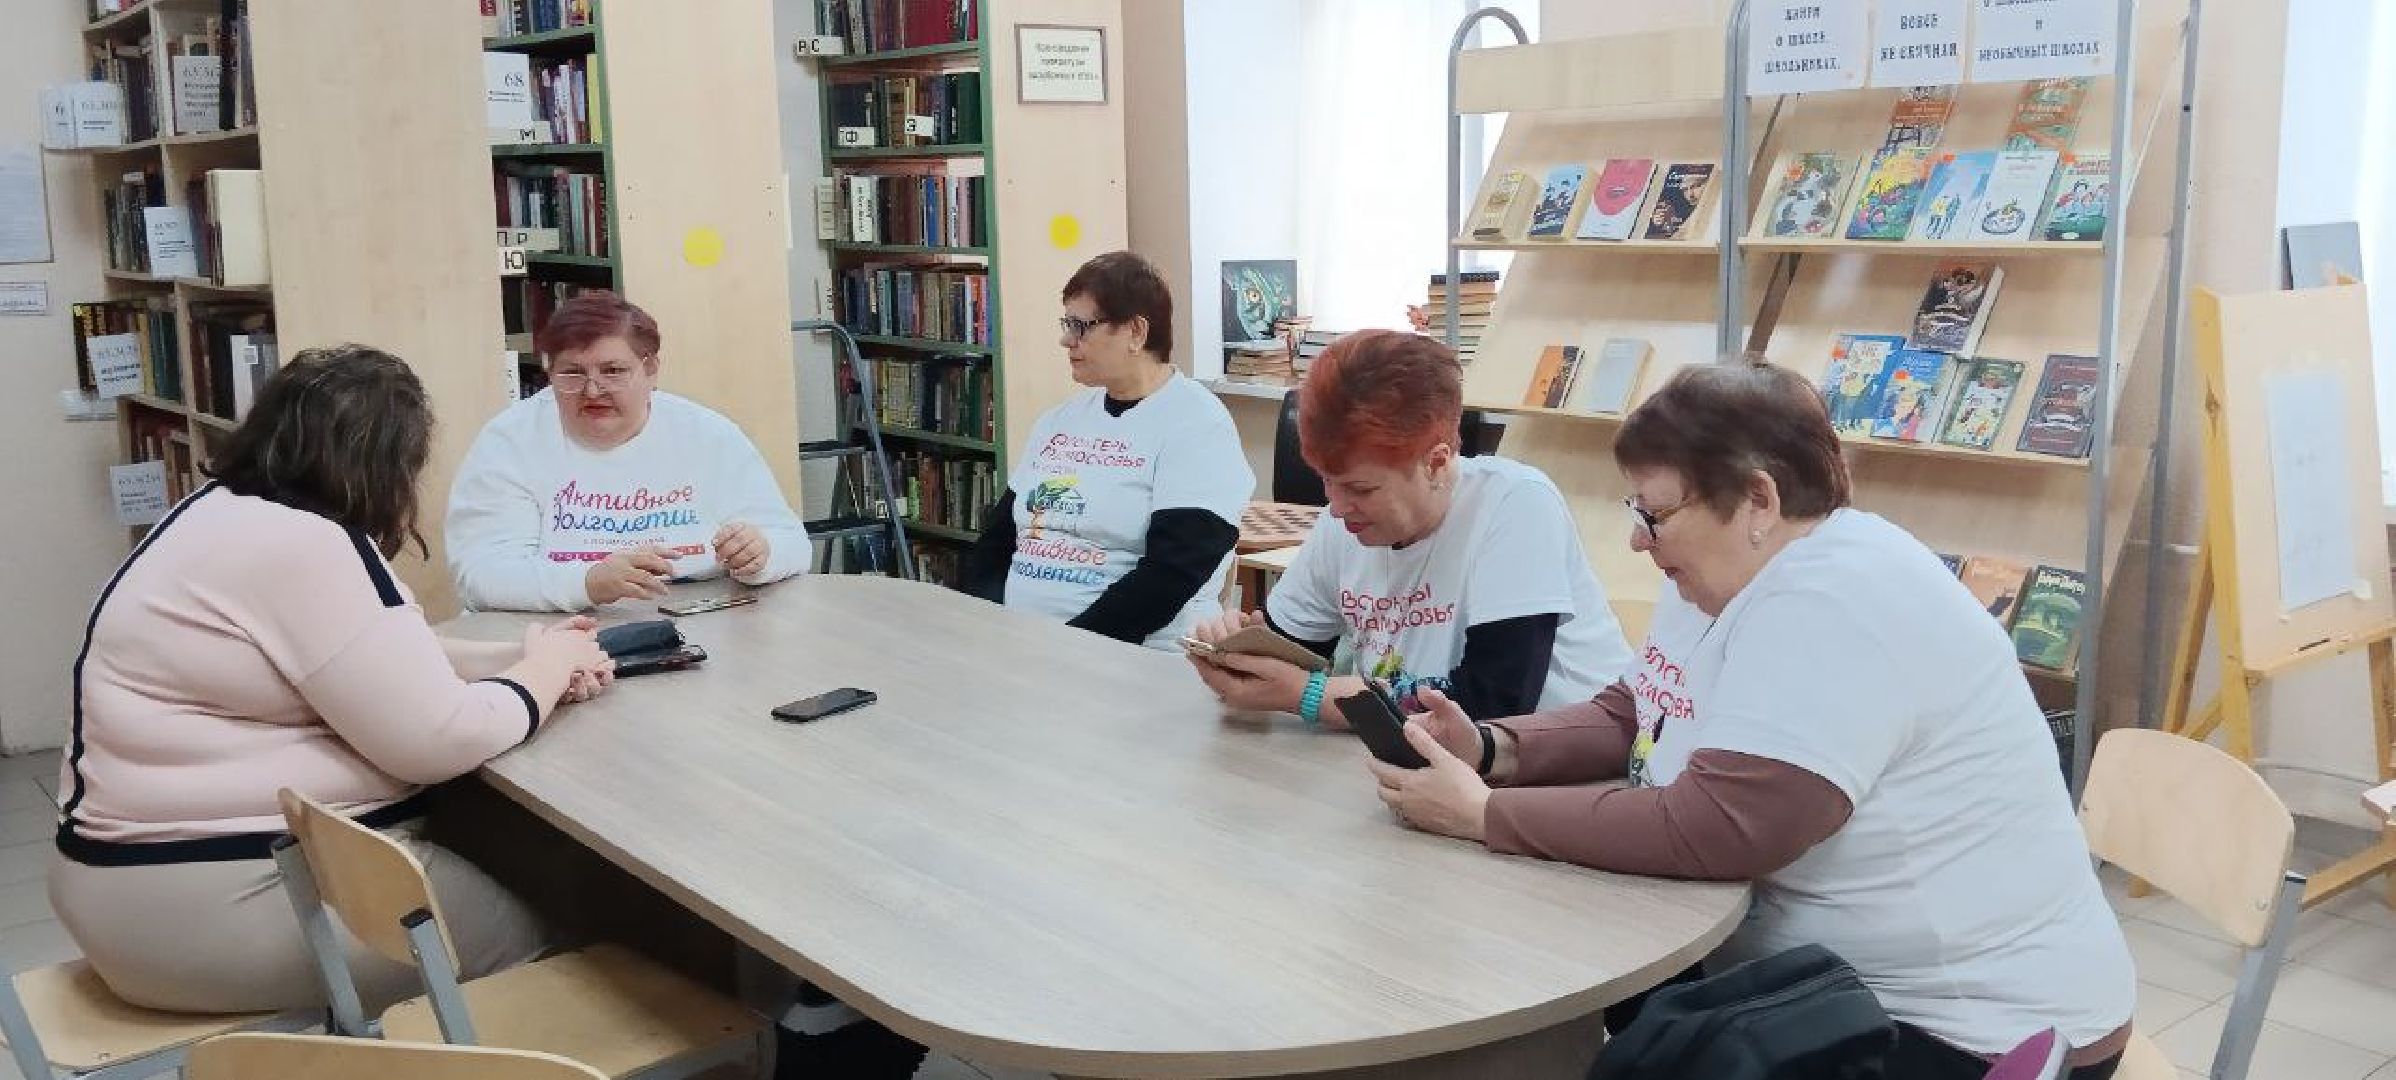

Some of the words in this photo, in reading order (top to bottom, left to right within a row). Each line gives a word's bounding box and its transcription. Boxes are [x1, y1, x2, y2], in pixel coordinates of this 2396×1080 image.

[797, 40, 807, 52] Р
[811, 38, 820, 53] С
[520, 128, 536, 141] М
[517, 232, 527, 244] Р
[504, 251, 525, 269] Ю
[553, 480, 693, 511] Активное
